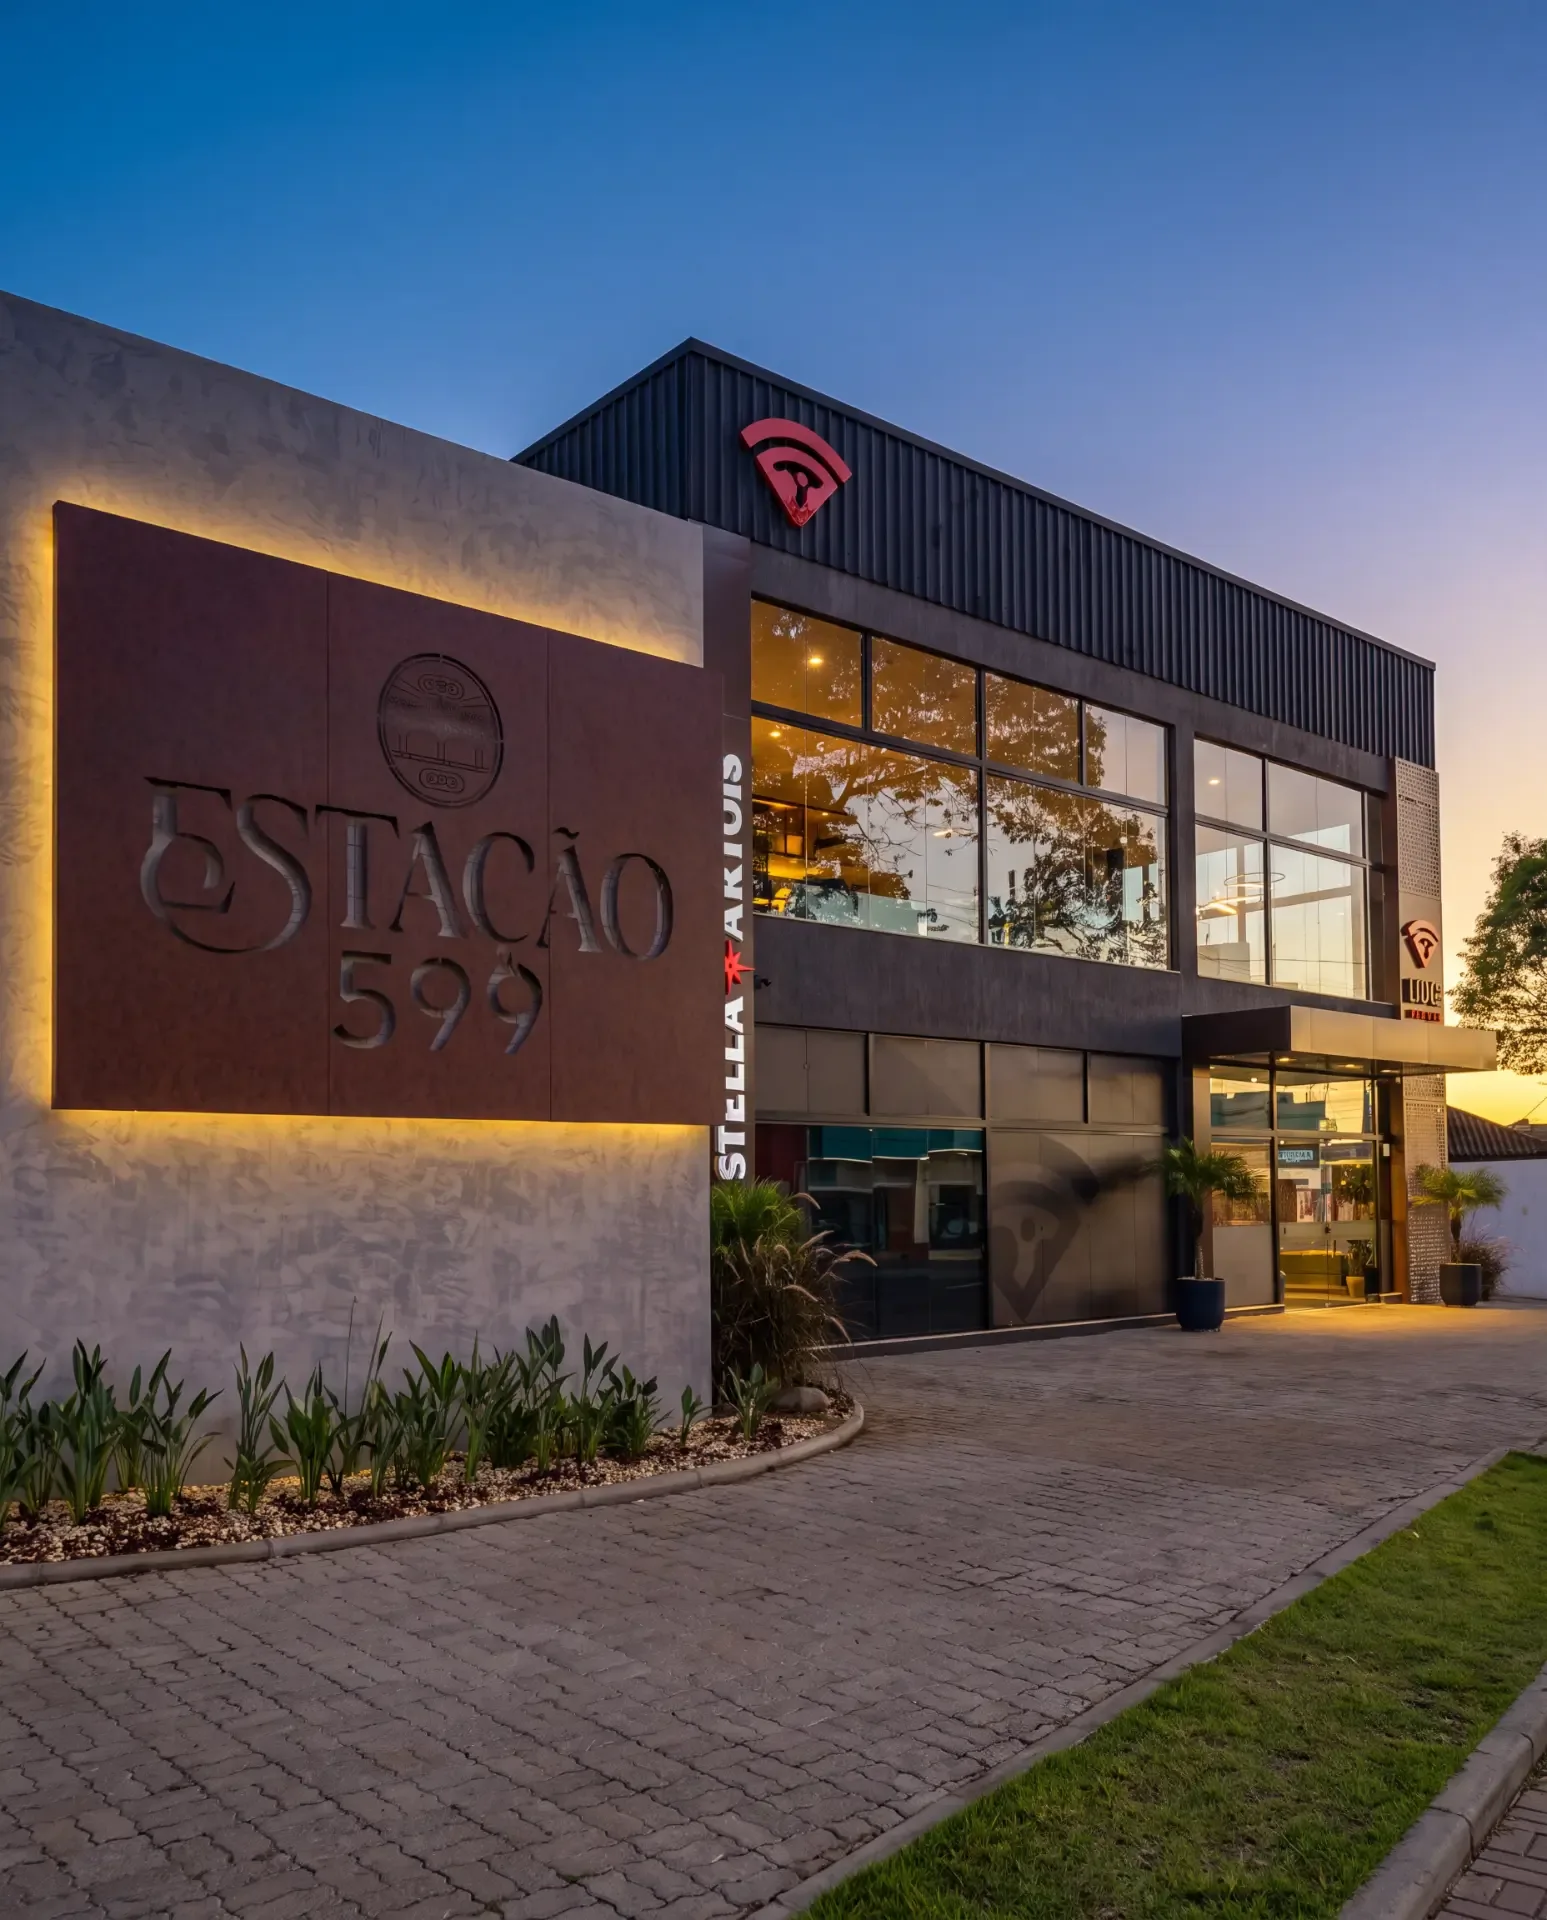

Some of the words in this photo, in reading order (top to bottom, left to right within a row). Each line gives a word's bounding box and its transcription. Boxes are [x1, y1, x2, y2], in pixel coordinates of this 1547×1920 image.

[140, 776, 674, 963] ESTAÇÃO
[333, 951, 543, 1055] 599
[714, 996, 746, 1180] STELLA
